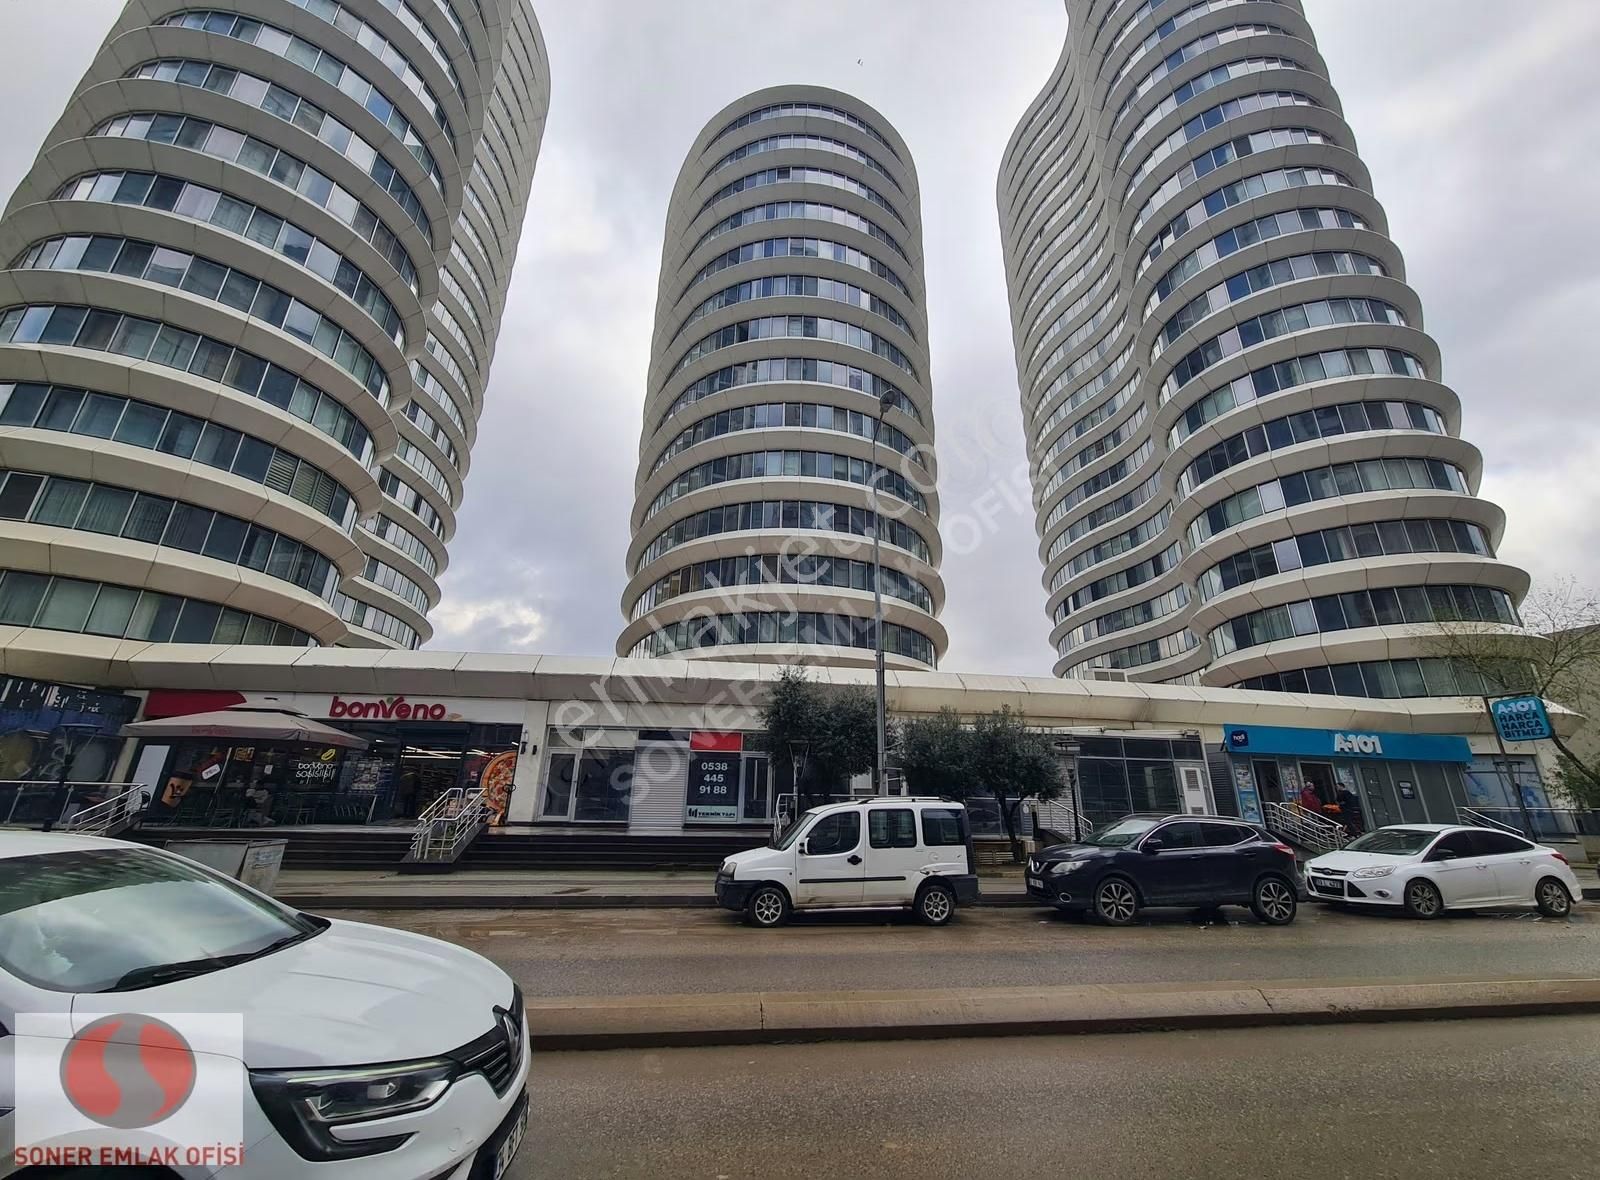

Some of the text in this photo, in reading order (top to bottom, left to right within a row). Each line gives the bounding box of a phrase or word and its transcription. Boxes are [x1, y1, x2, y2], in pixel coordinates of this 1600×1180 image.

[1499, 712, 1540, 722] HARCA
[1501, 720, 1543, 730] HARCA
[701, 762, 728, 771] 0538
[703, 773, 724, 782] 445
[699, 785, 727, 794] 91 88
